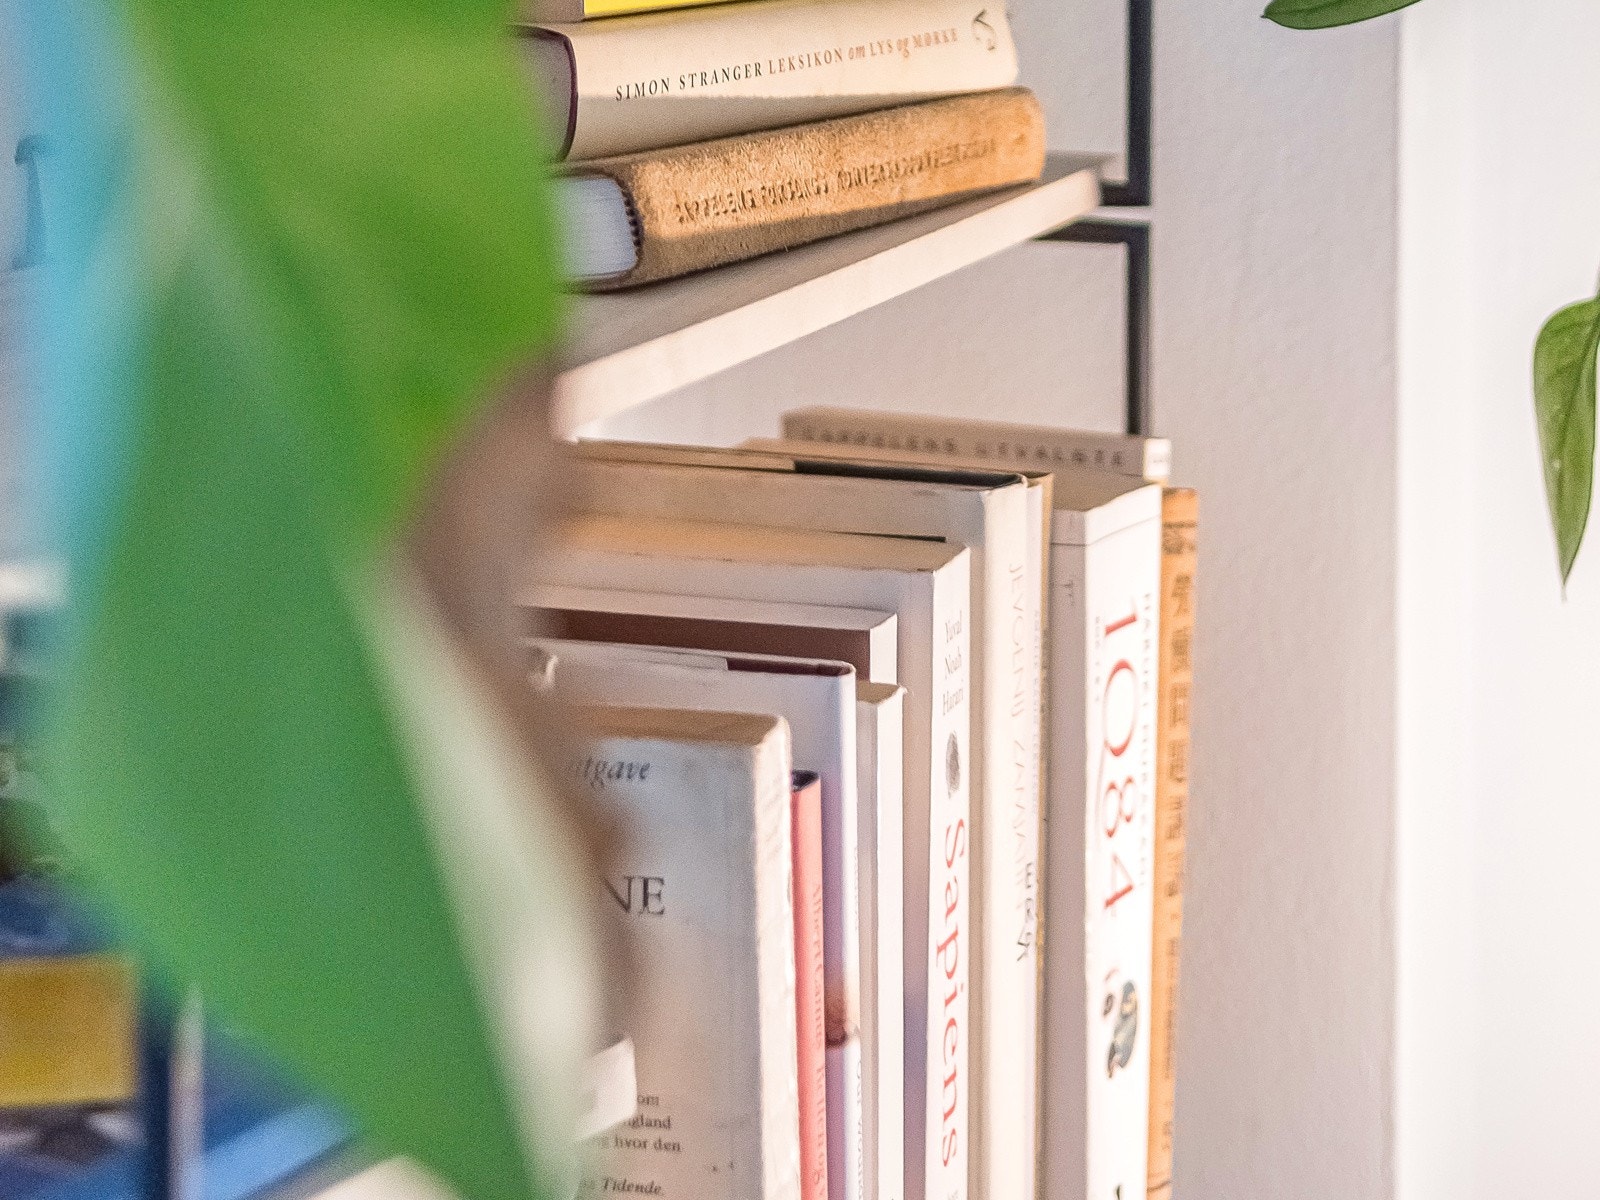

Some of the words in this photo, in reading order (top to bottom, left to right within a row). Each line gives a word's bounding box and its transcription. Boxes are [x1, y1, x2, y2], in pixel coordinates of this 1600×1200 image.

[615, 77, 670, 102] SIMON
[679, 62, 763, 90] STRANGER
[768, 47, 843, 74] LEKSIKON
[848, 45, 866, 60] om
[869, 39, 893, 57] LYS
[896, 37, 910, 58] og
[580, 757, 651, 792] tgave
[936, 819, 965, 1168] Sapiens
[614, 1135, 647, 1150] hvor
[653, 1136, 681, 1152] den
